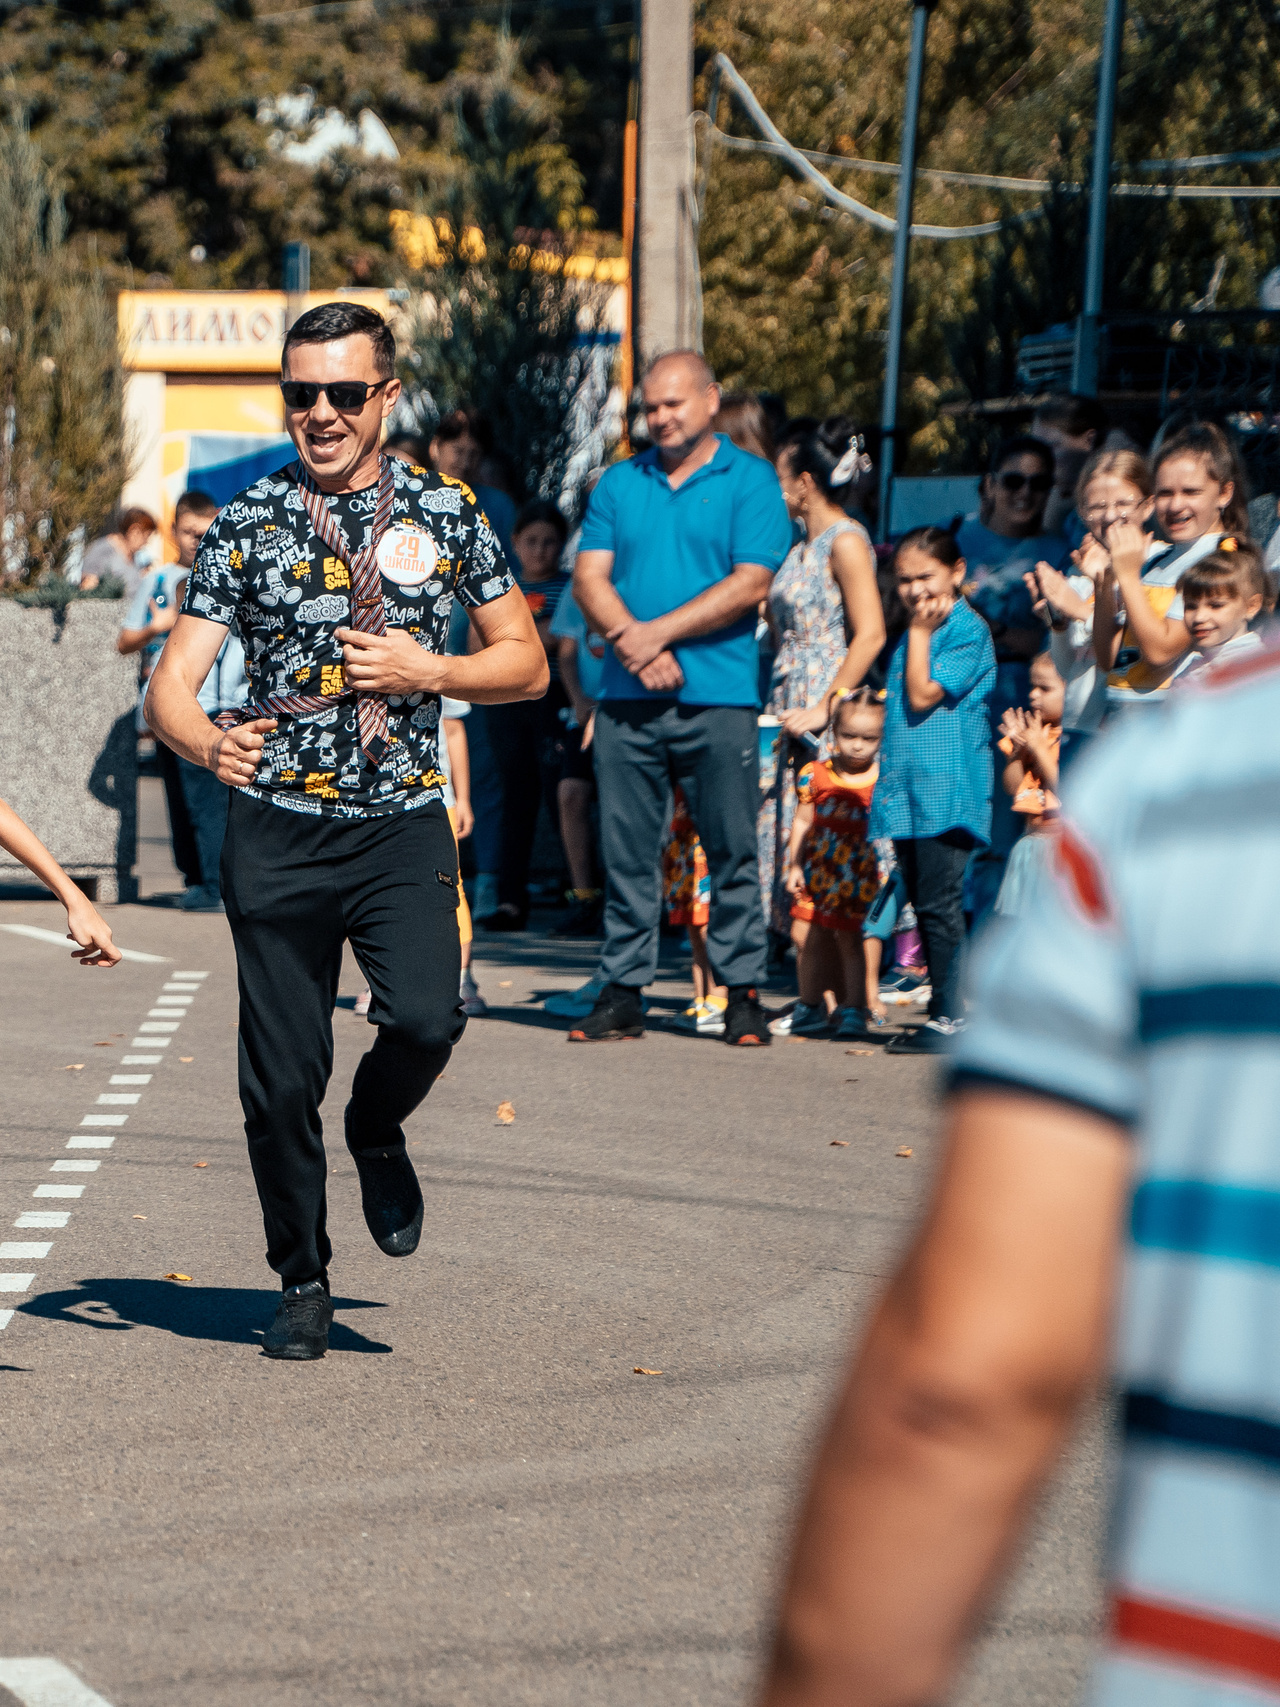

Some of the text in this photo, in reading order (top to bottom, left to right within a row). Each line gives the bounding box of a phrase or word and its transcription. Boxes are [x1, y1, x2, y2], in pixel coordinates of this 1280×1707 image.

[361, 487, 379, 501] YE
[256, 525, 285, 542] Bart
[256, 533, 297, 562] WHO THE
[395, 534, 421, 559] 29
[276, 542, 316, 572] HELL
[384, 555, 426, 573] ШКОЛА
[292, 567, 312, 579] you
[308, 603, 344, 621] COW
[287, 643, 302, 657] THE
[275, 741, 290, 754] THE
[396, 750, 411, 762] THE
[269, 752, 302, 773] HELL
